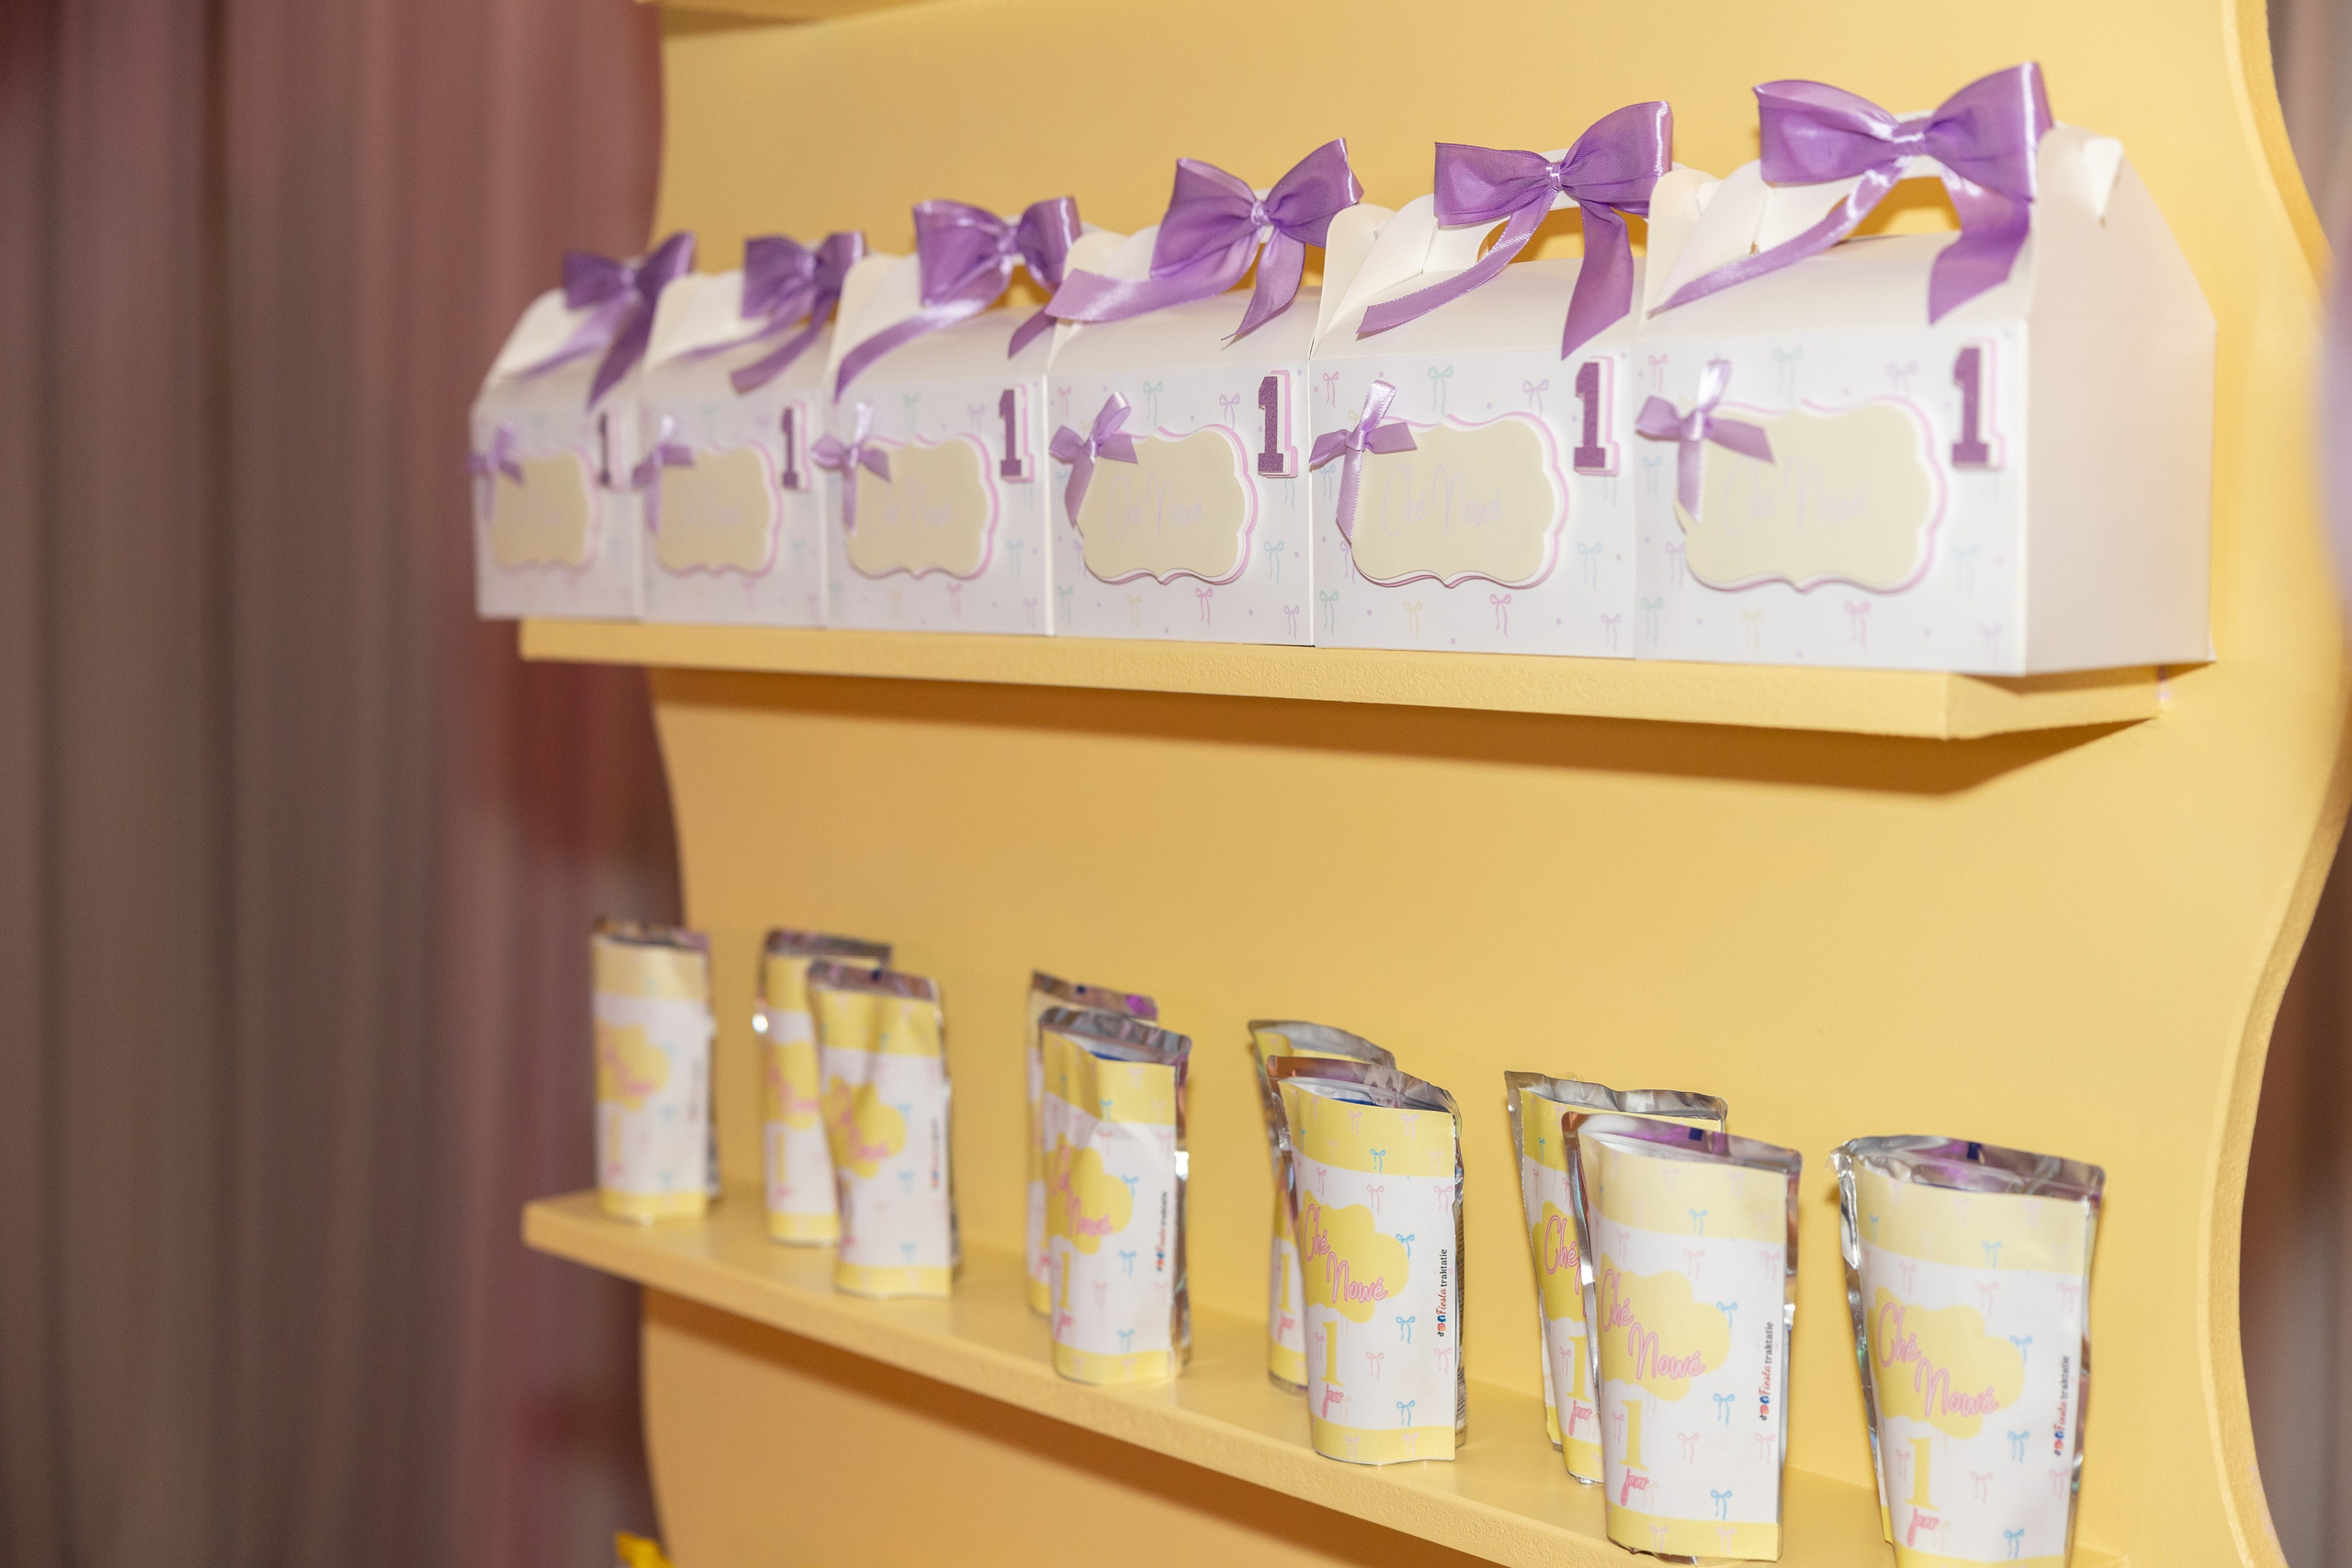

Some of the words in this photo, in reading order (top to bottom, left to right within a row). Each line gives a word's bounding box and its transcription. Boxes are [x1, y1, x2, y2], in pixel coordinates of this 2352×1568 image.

[999, 387, 1028, 480] 1
[1258, 372, 1294, 475] 1
[1574, 359, 1614, 473] 1
[1951, 340, 1997, 470] 1
[781, 405, 805, 490] 1
[1383, 465, 1429, 537] Ché
[1305, 1203, 1330, 1261] Ché
[1544, 1214, 1578, 1275] Ché
[1328, 1253, 1387, 1303] Nowé
[1439, 1248, 1448, 1287] traktatie
[1435, 1287, 1447, 1315] Fiesta
[1600, 1269, 1634, 1331] Ché
[1323, 1322, 1343, 1386] 1
[1629, 1322, 1706, 1380] Nowé
[1764, 1322, 1774, 1364] traktatie
[1878, 1303, 1922, 1369] Ché
[1567, 1334, 1592, 1402] 1
[1758, 1366, 1771, 1395] Fiesta
[1915, 1357, 1999, 1416] Nowé
[1568, 1399, 1592, 1436] jaar
[1620, 1399, 1649, 1471] 1
[1621, 1468, 1649, 1506] jaar
[1905, 1437, 1940, 1510] 1
[1908, 1507, 1939, 1546] jaar
